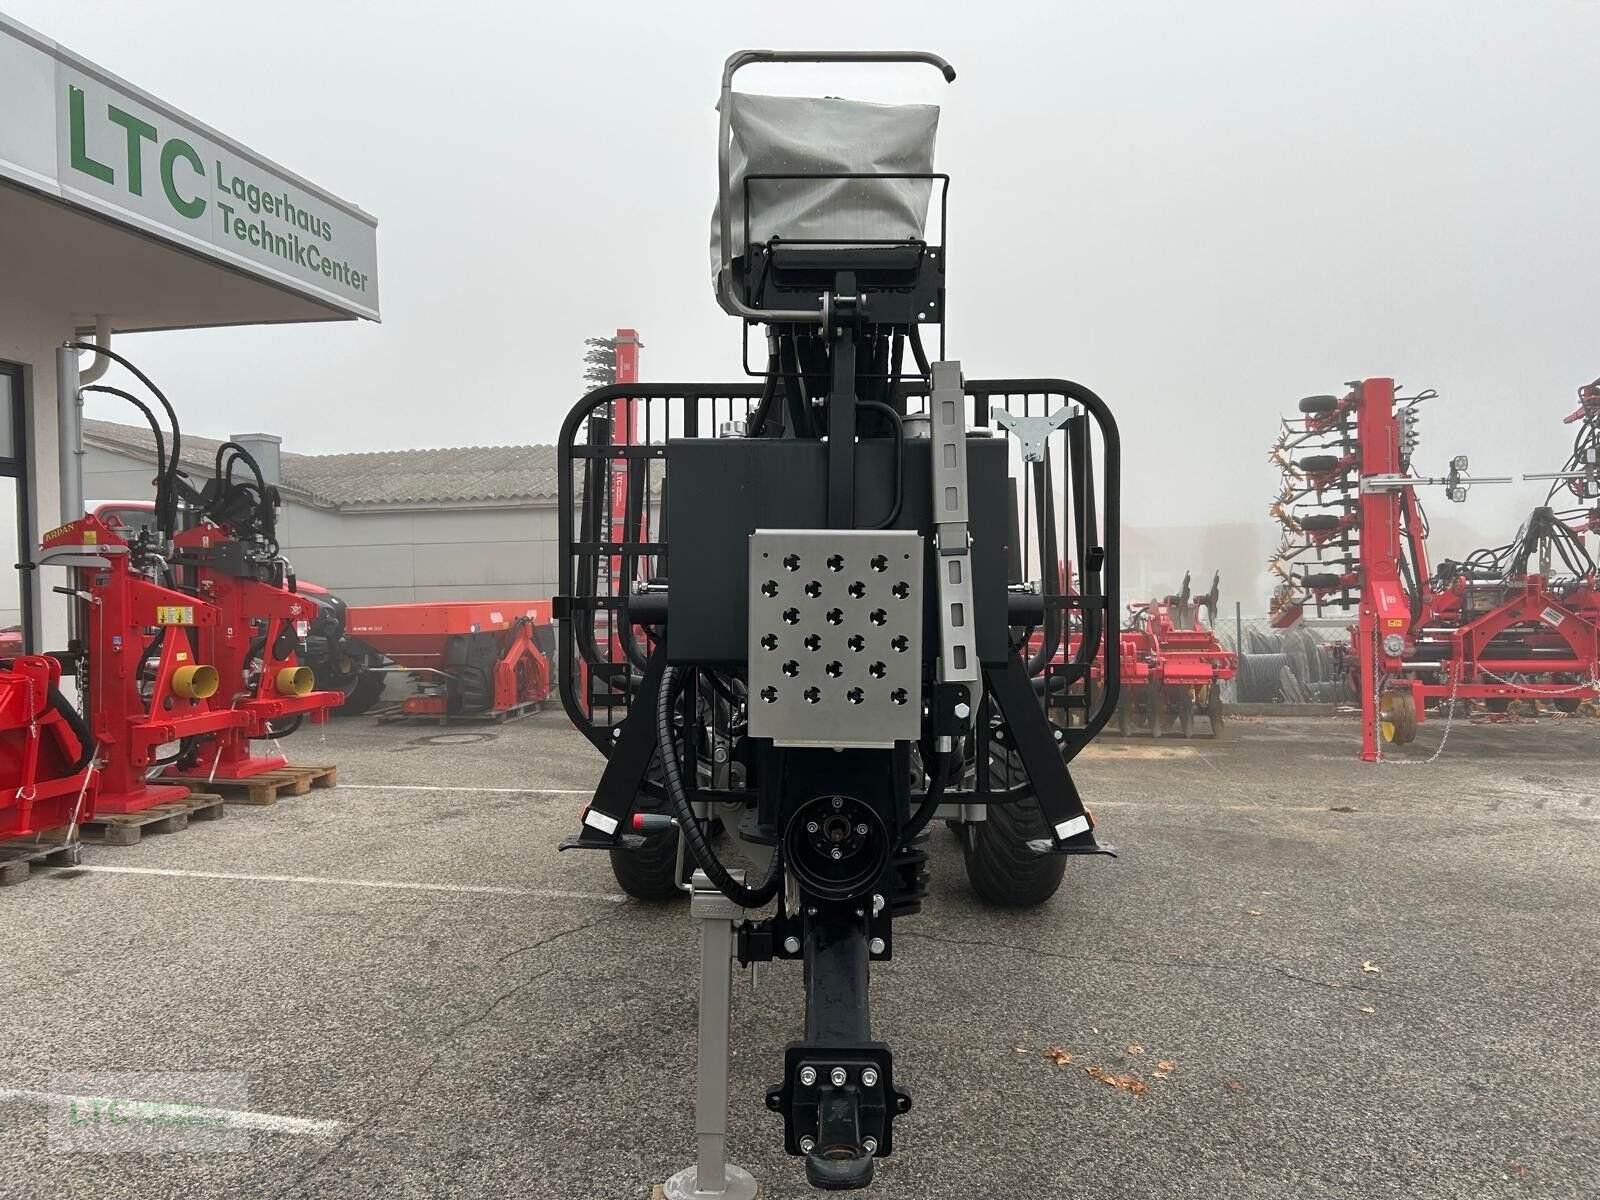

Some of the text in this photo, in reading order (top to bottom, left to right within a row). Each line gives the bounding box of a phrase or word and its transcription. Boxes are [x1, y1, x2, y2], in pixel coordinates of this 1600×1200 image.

[69, 84, 207, 220] LTC
[216, 159, 332, 242] Lagerhaus
[217, 201, 368, 292] TechnikCenter
